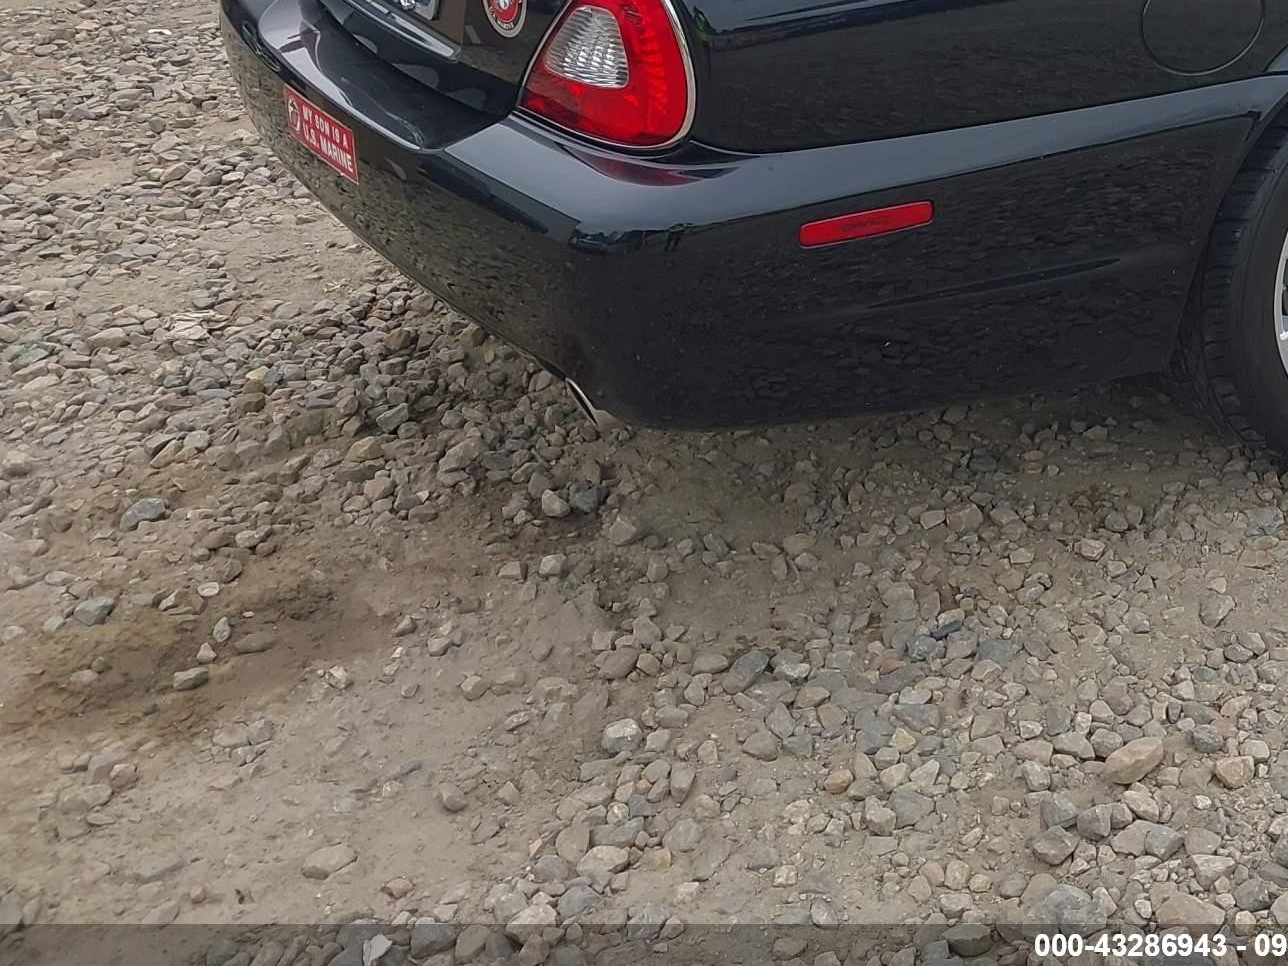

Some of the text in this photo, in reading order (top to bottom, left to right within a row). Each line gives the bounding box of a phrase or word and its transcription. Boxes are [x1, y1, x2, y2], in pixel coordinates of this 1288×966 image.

[302, 105, 349, 150] MY SON IS A
[302, 122, 354, 174] U.S. MARINE
